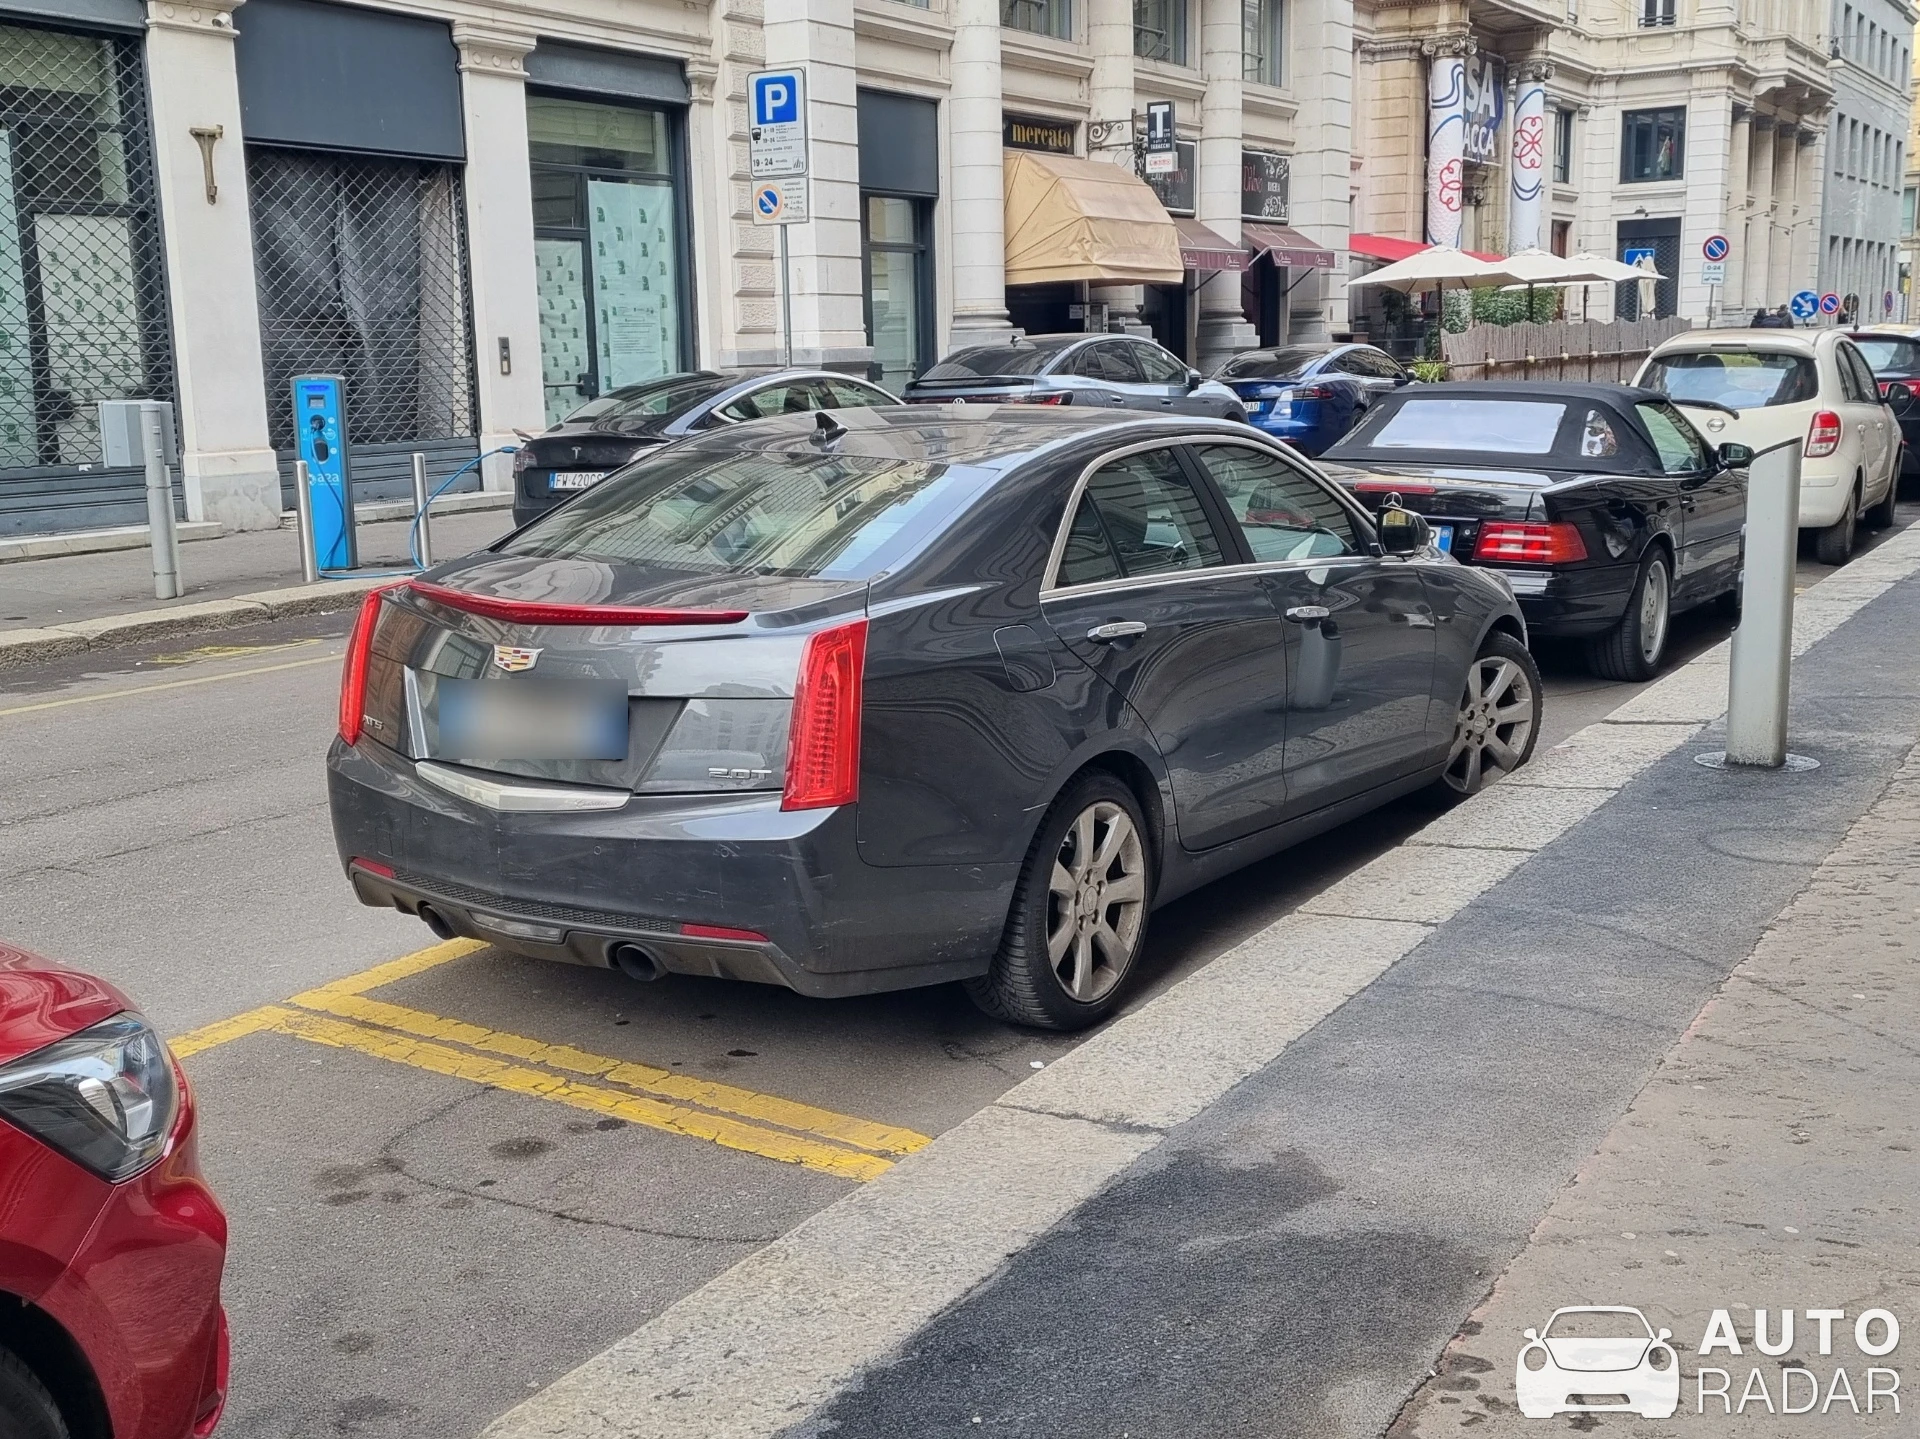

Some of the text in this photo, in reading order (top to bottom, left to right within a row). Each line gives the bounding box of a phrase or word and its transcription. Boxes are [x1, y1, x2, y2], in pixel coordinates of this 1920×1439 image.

[765, 84, 788, 120] P
[1466, 56, 1496, 118] SA
[1012, 124, 1071, 147] mercato
[1149, 104, 1170, 138] T
[1463, 122, 1495, 157] ACCA
[556, 474, 568, 487] FW
